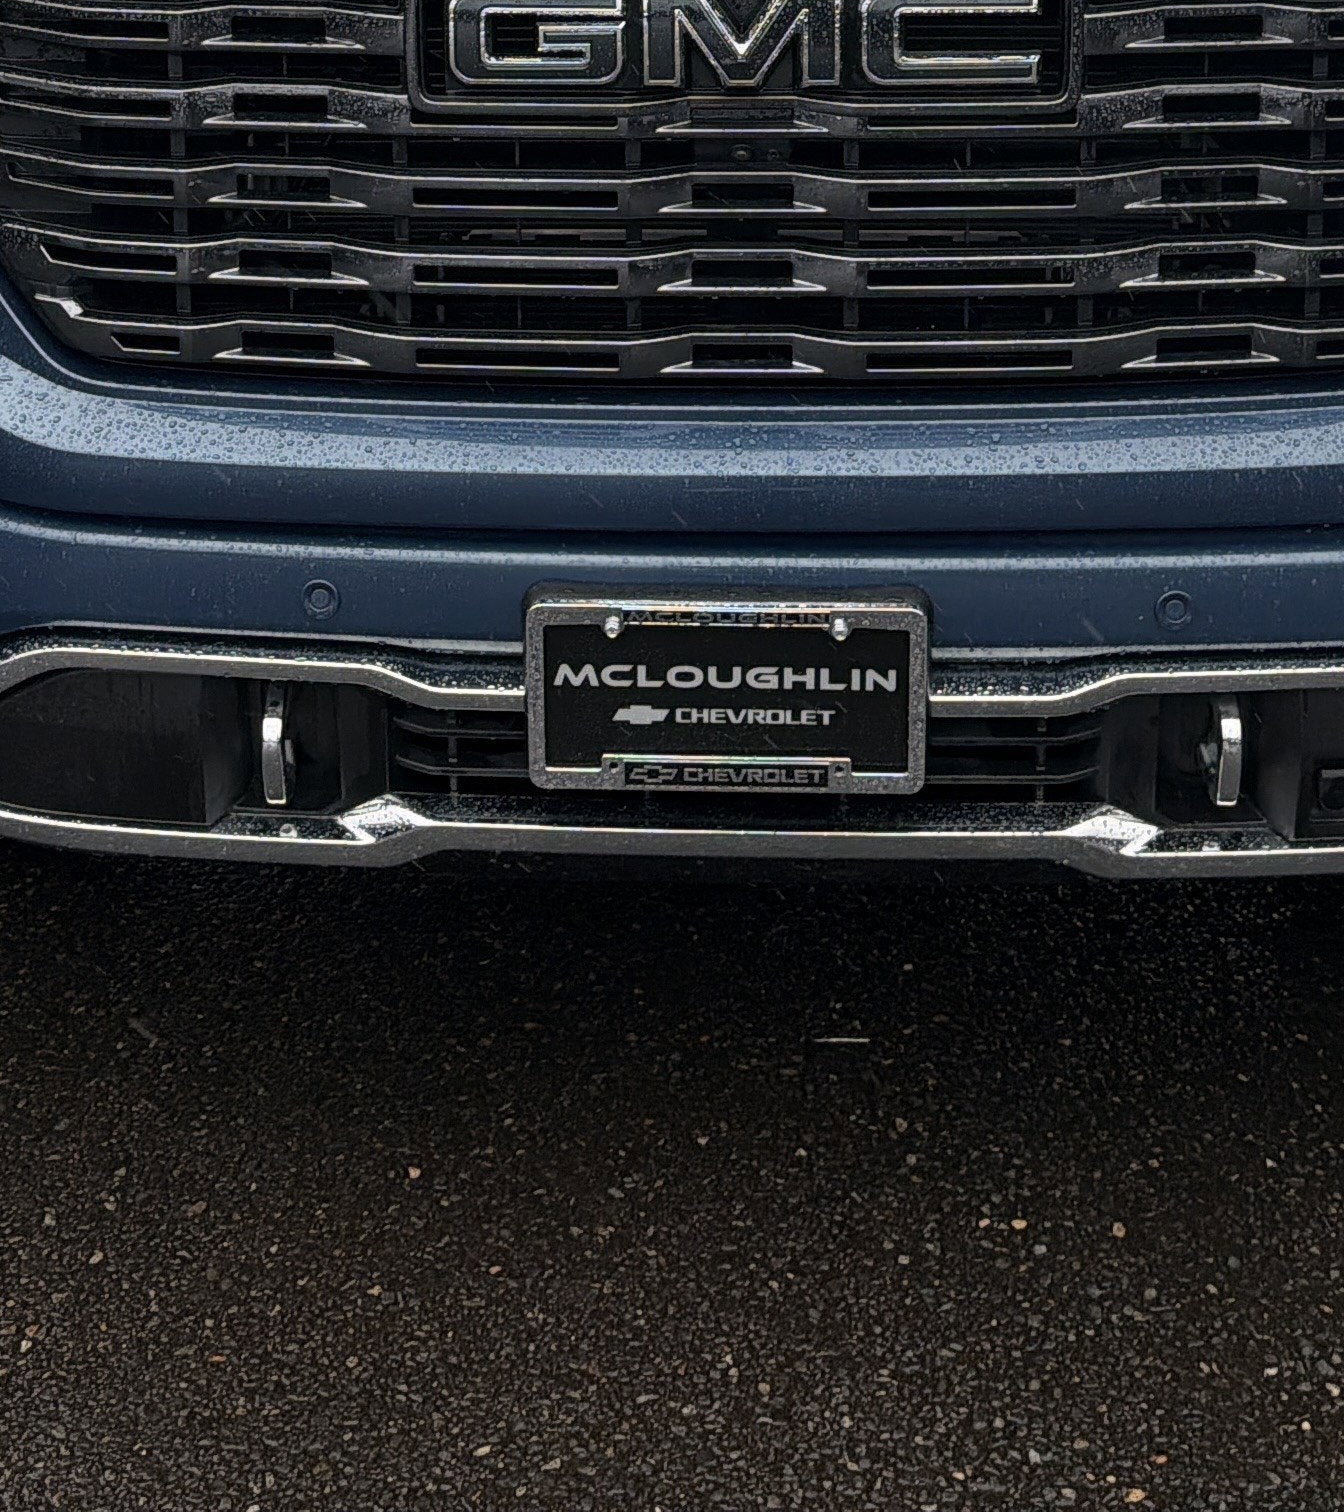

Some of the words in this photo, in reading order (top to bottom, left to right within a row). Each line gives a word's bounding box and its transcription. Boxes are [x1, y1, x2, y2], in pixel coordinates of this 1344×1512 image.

[553, 663, 897, 692] MCLOUGHLIN
[675, 707, 836, 725] CHEVROLET
[683, 767, 825, 784] CHEVROLET
